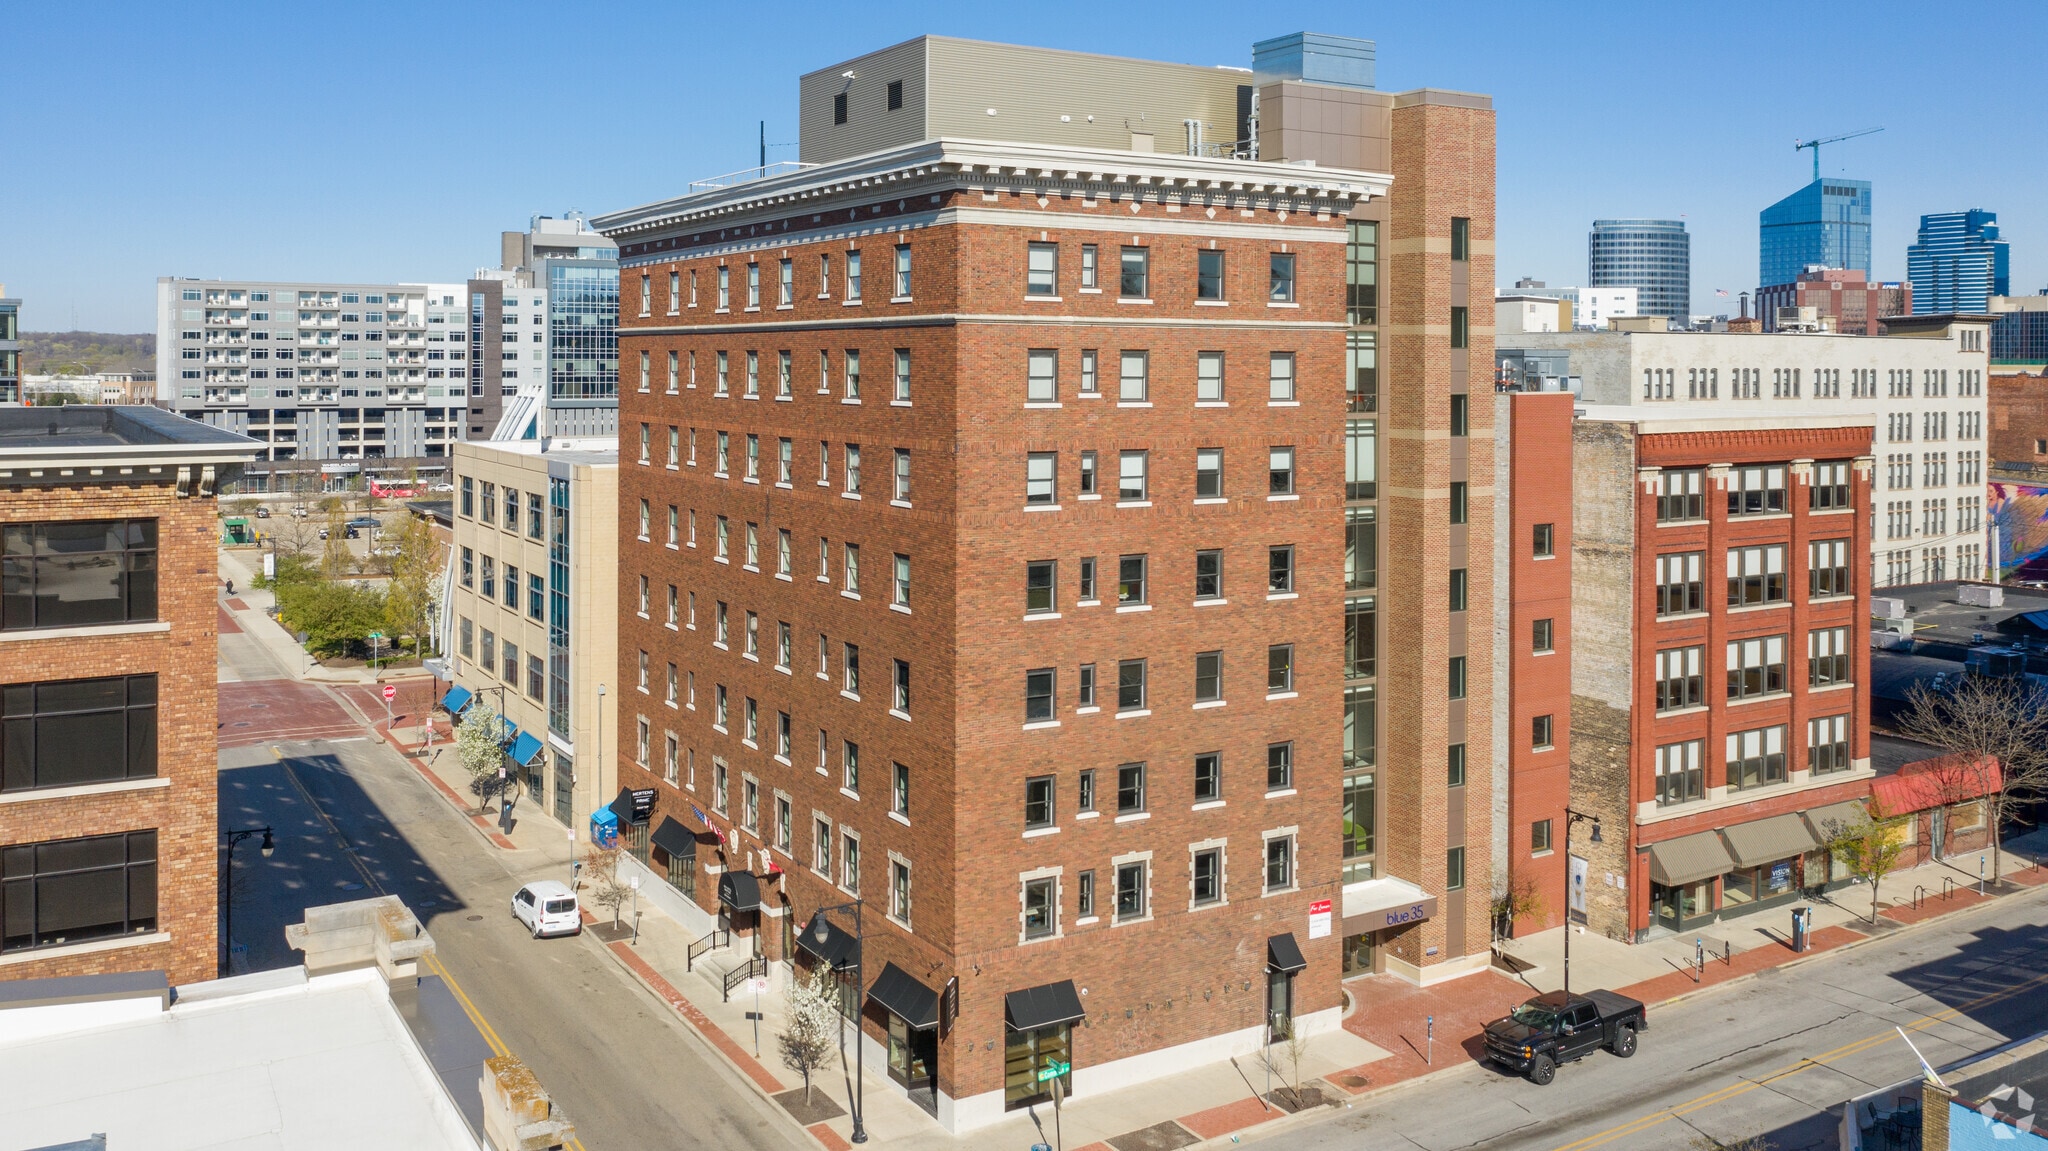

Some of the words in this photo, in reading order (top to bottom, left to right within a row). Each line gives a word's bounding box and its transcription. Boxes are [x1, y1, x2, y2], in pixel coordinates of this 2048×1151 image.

[1771, 868, 1790, 877] VISION
[1387, 911, 1409, 925] blue
[1411, 904, 1423, 920] 35
